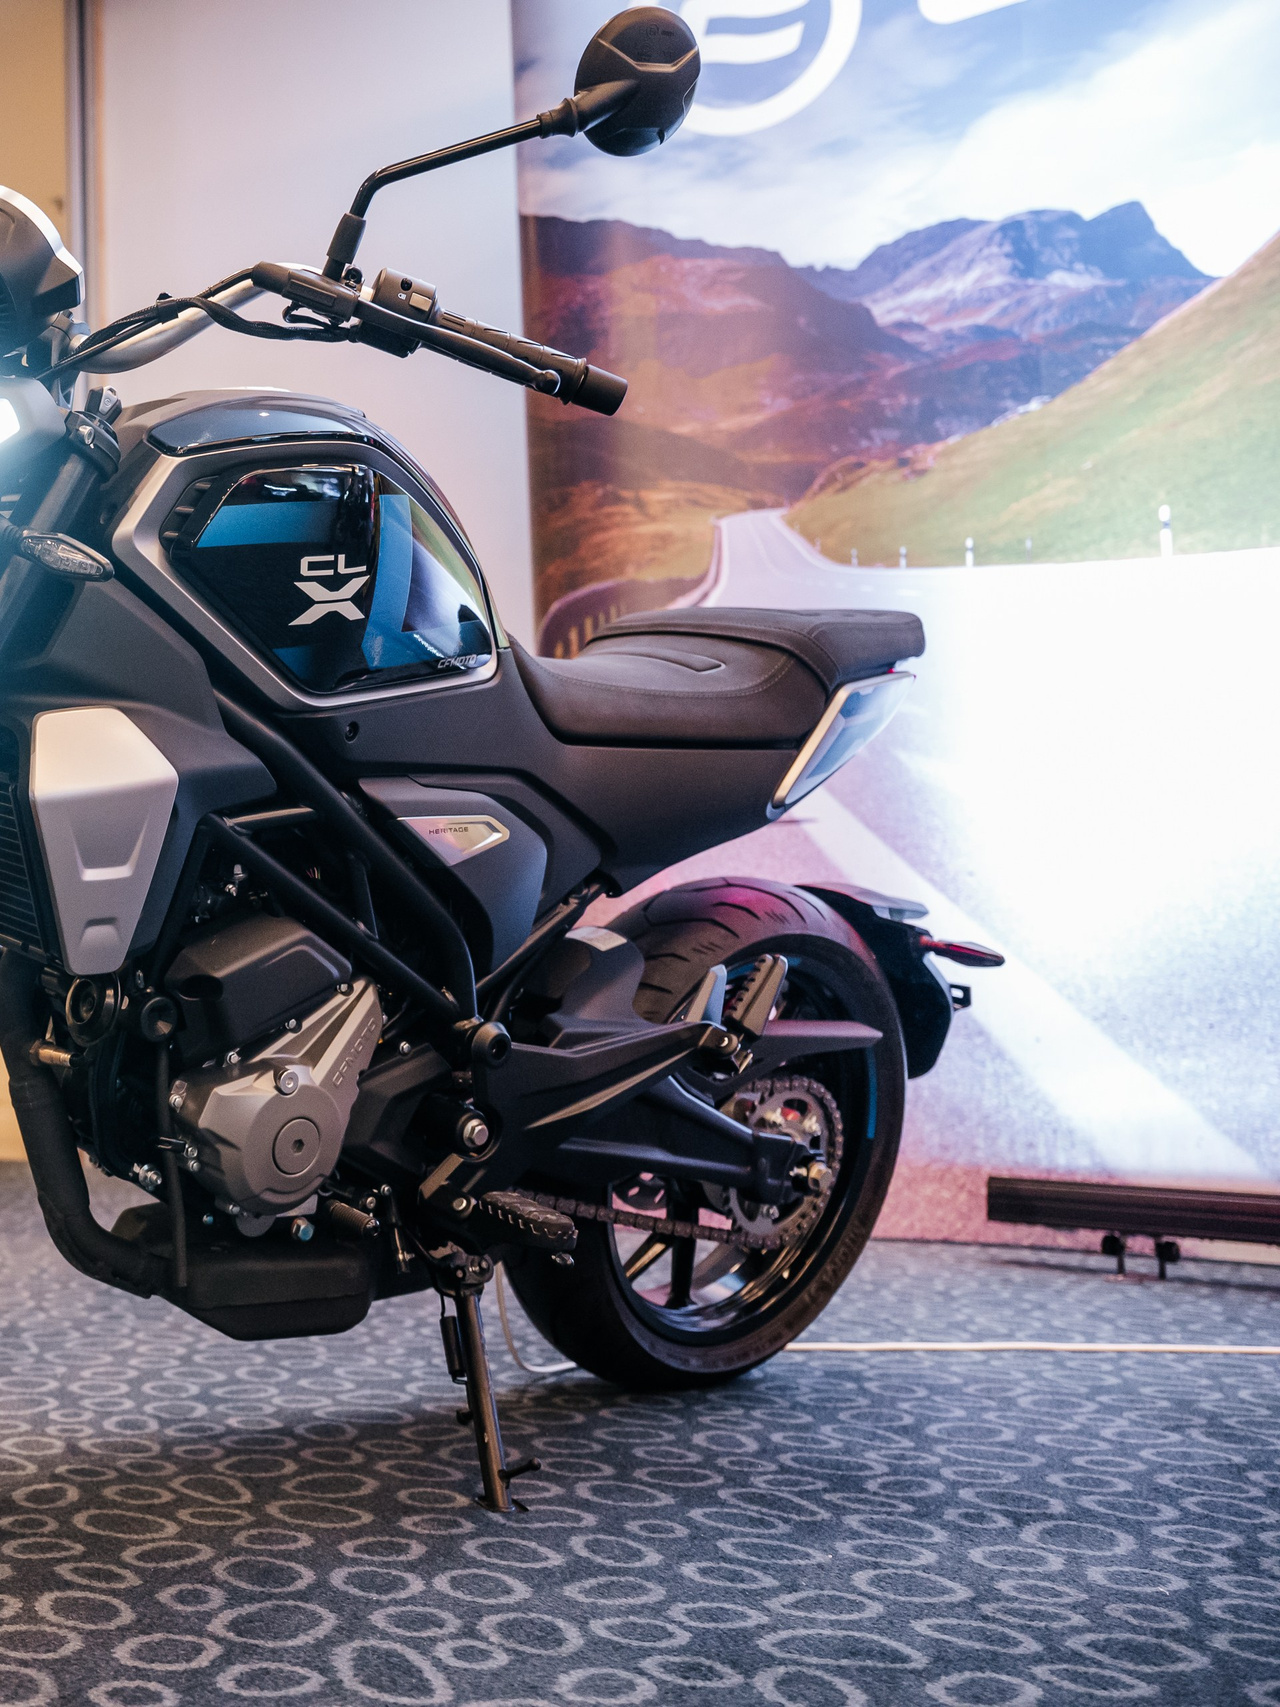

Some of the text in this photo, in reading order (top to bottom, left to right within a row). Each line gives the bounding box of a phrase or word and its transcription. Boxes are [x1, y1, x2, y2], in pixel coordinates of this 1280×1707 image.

[300, 554, 367, 576] CL
[288, 576, 370, 625] X
[437, 654, 477, 669] CFMOTO
[428, 826, 469, 835] HERITAGE
